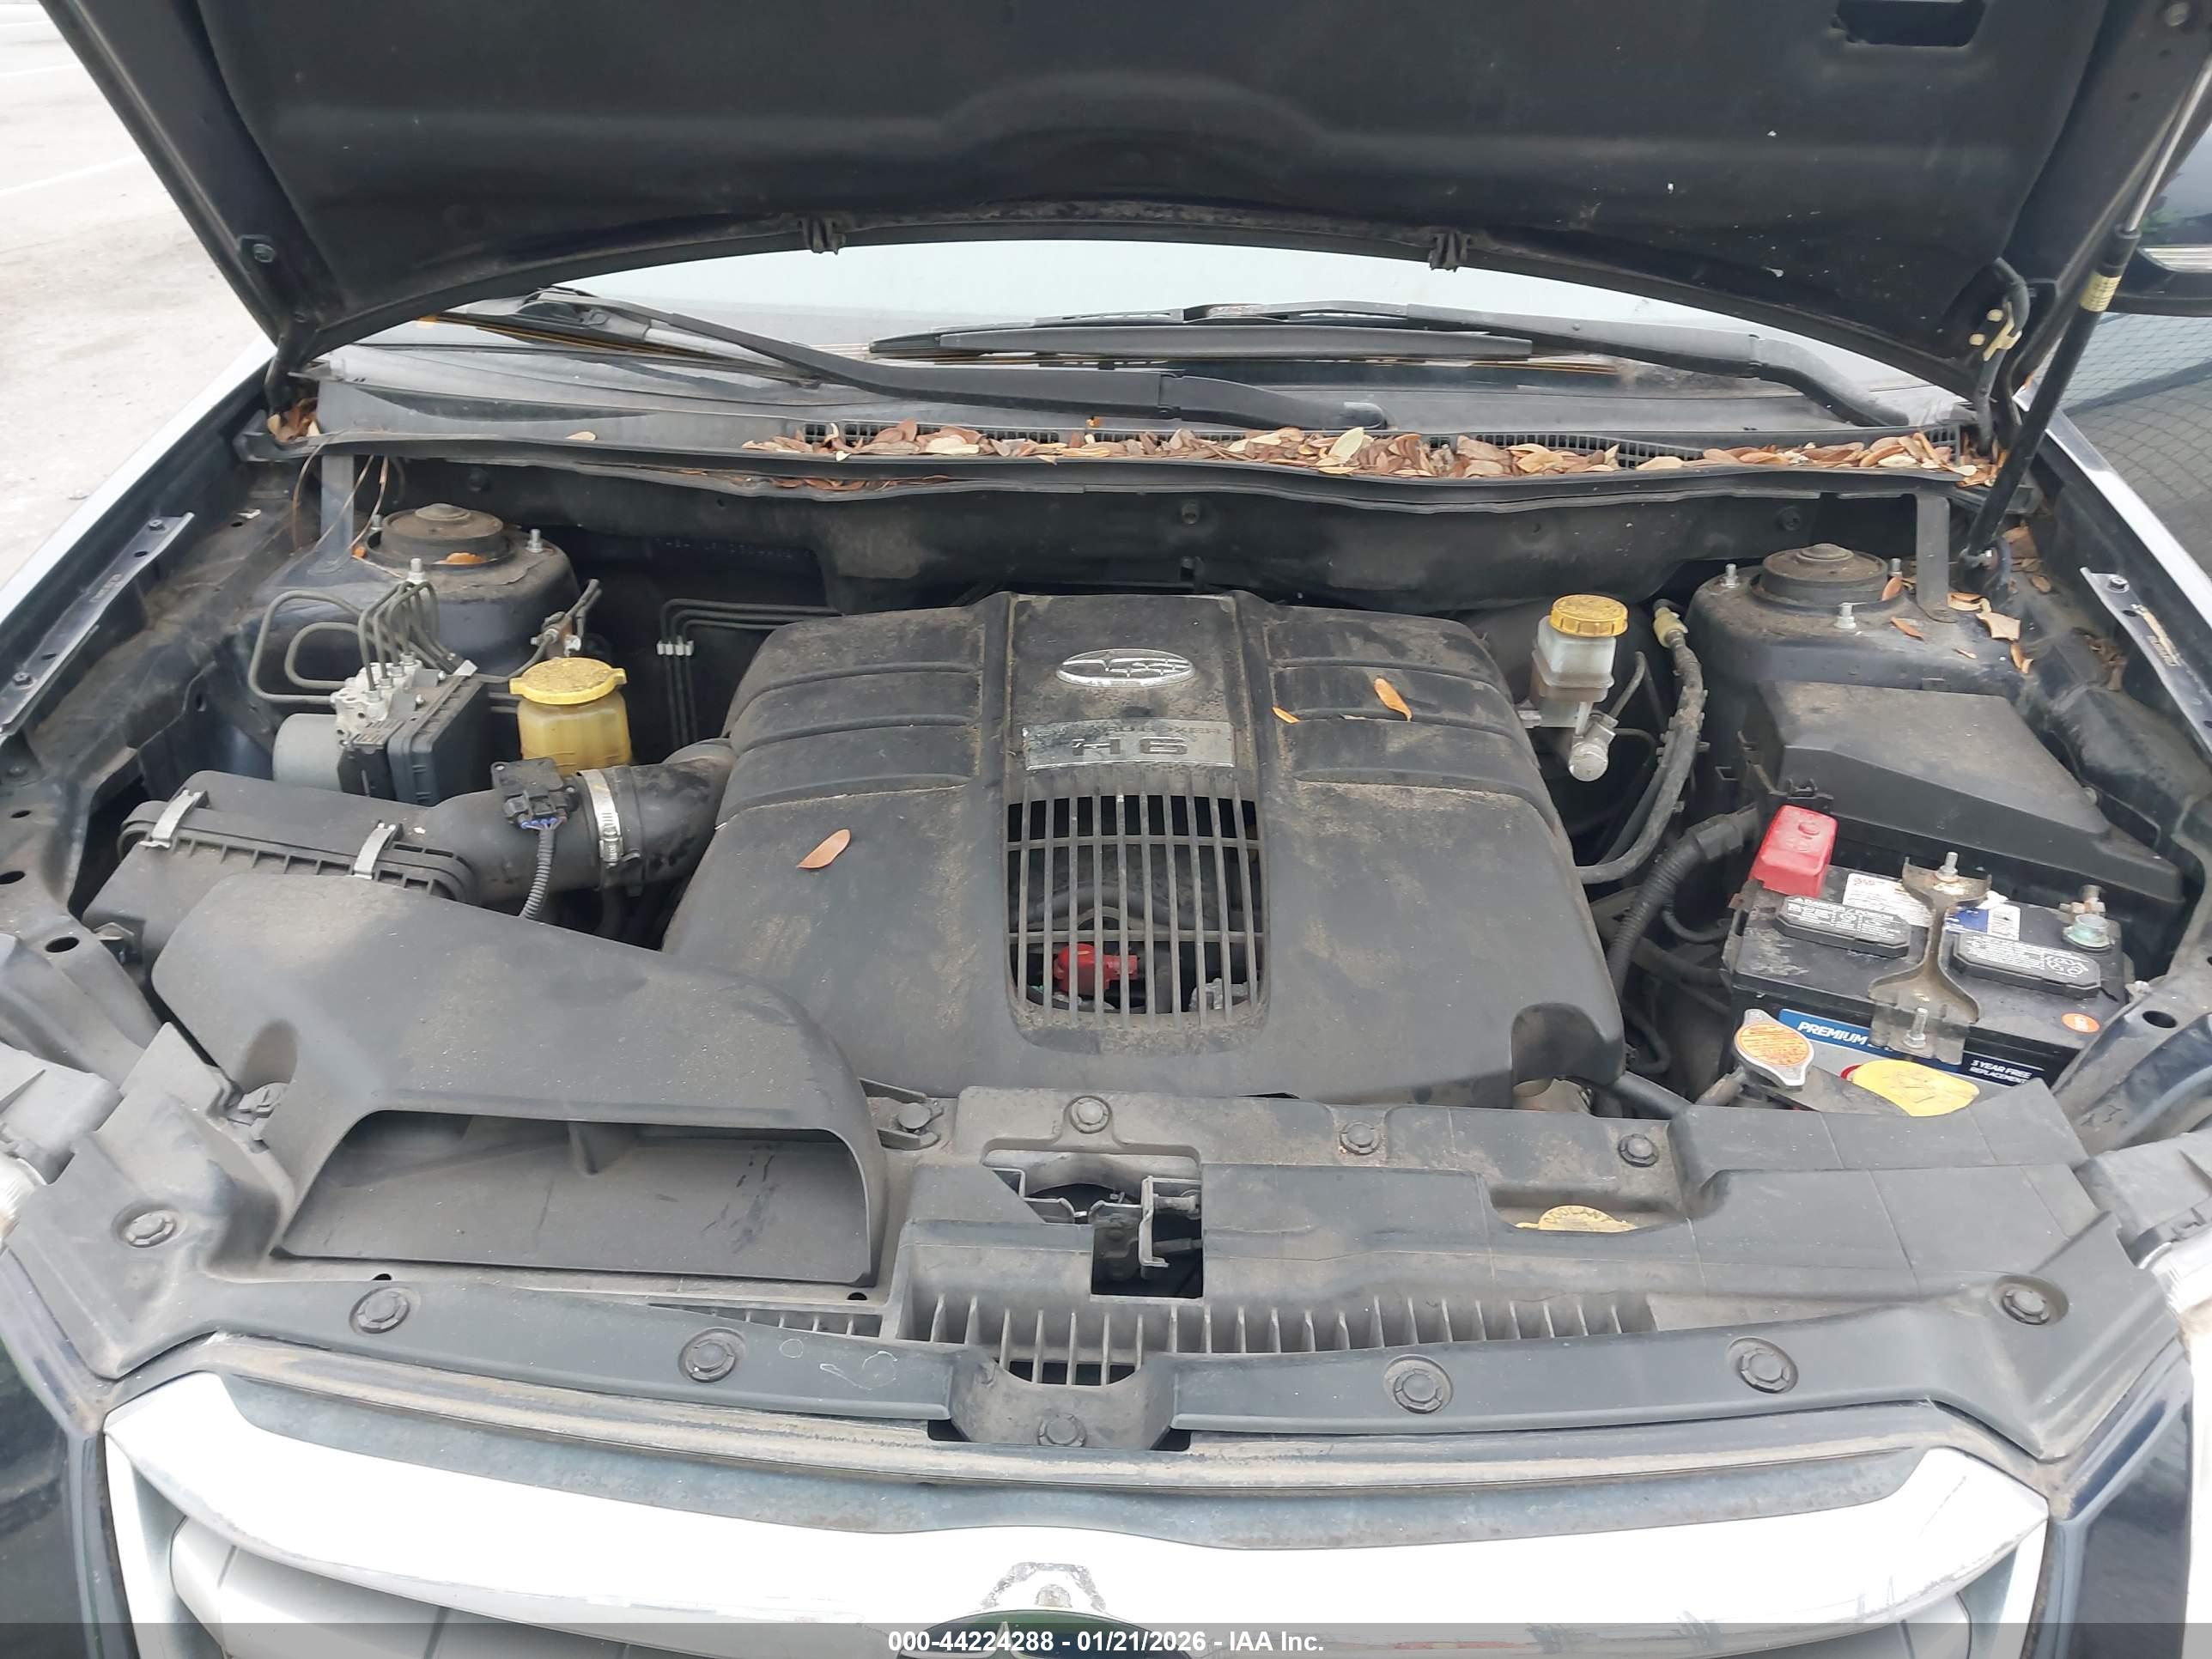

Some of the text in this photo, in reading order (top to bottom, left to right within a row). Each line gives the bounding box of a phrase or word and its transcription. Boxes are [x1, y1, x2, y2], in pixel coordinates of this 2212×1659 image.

[1071, 736, 1188, 757] H6
[1796, 1021, 1869, 1046] PREMIUM
[1978, 1061, 2007, 1073] YEAR
[2004, 1067, 2033, 1079] FREE
